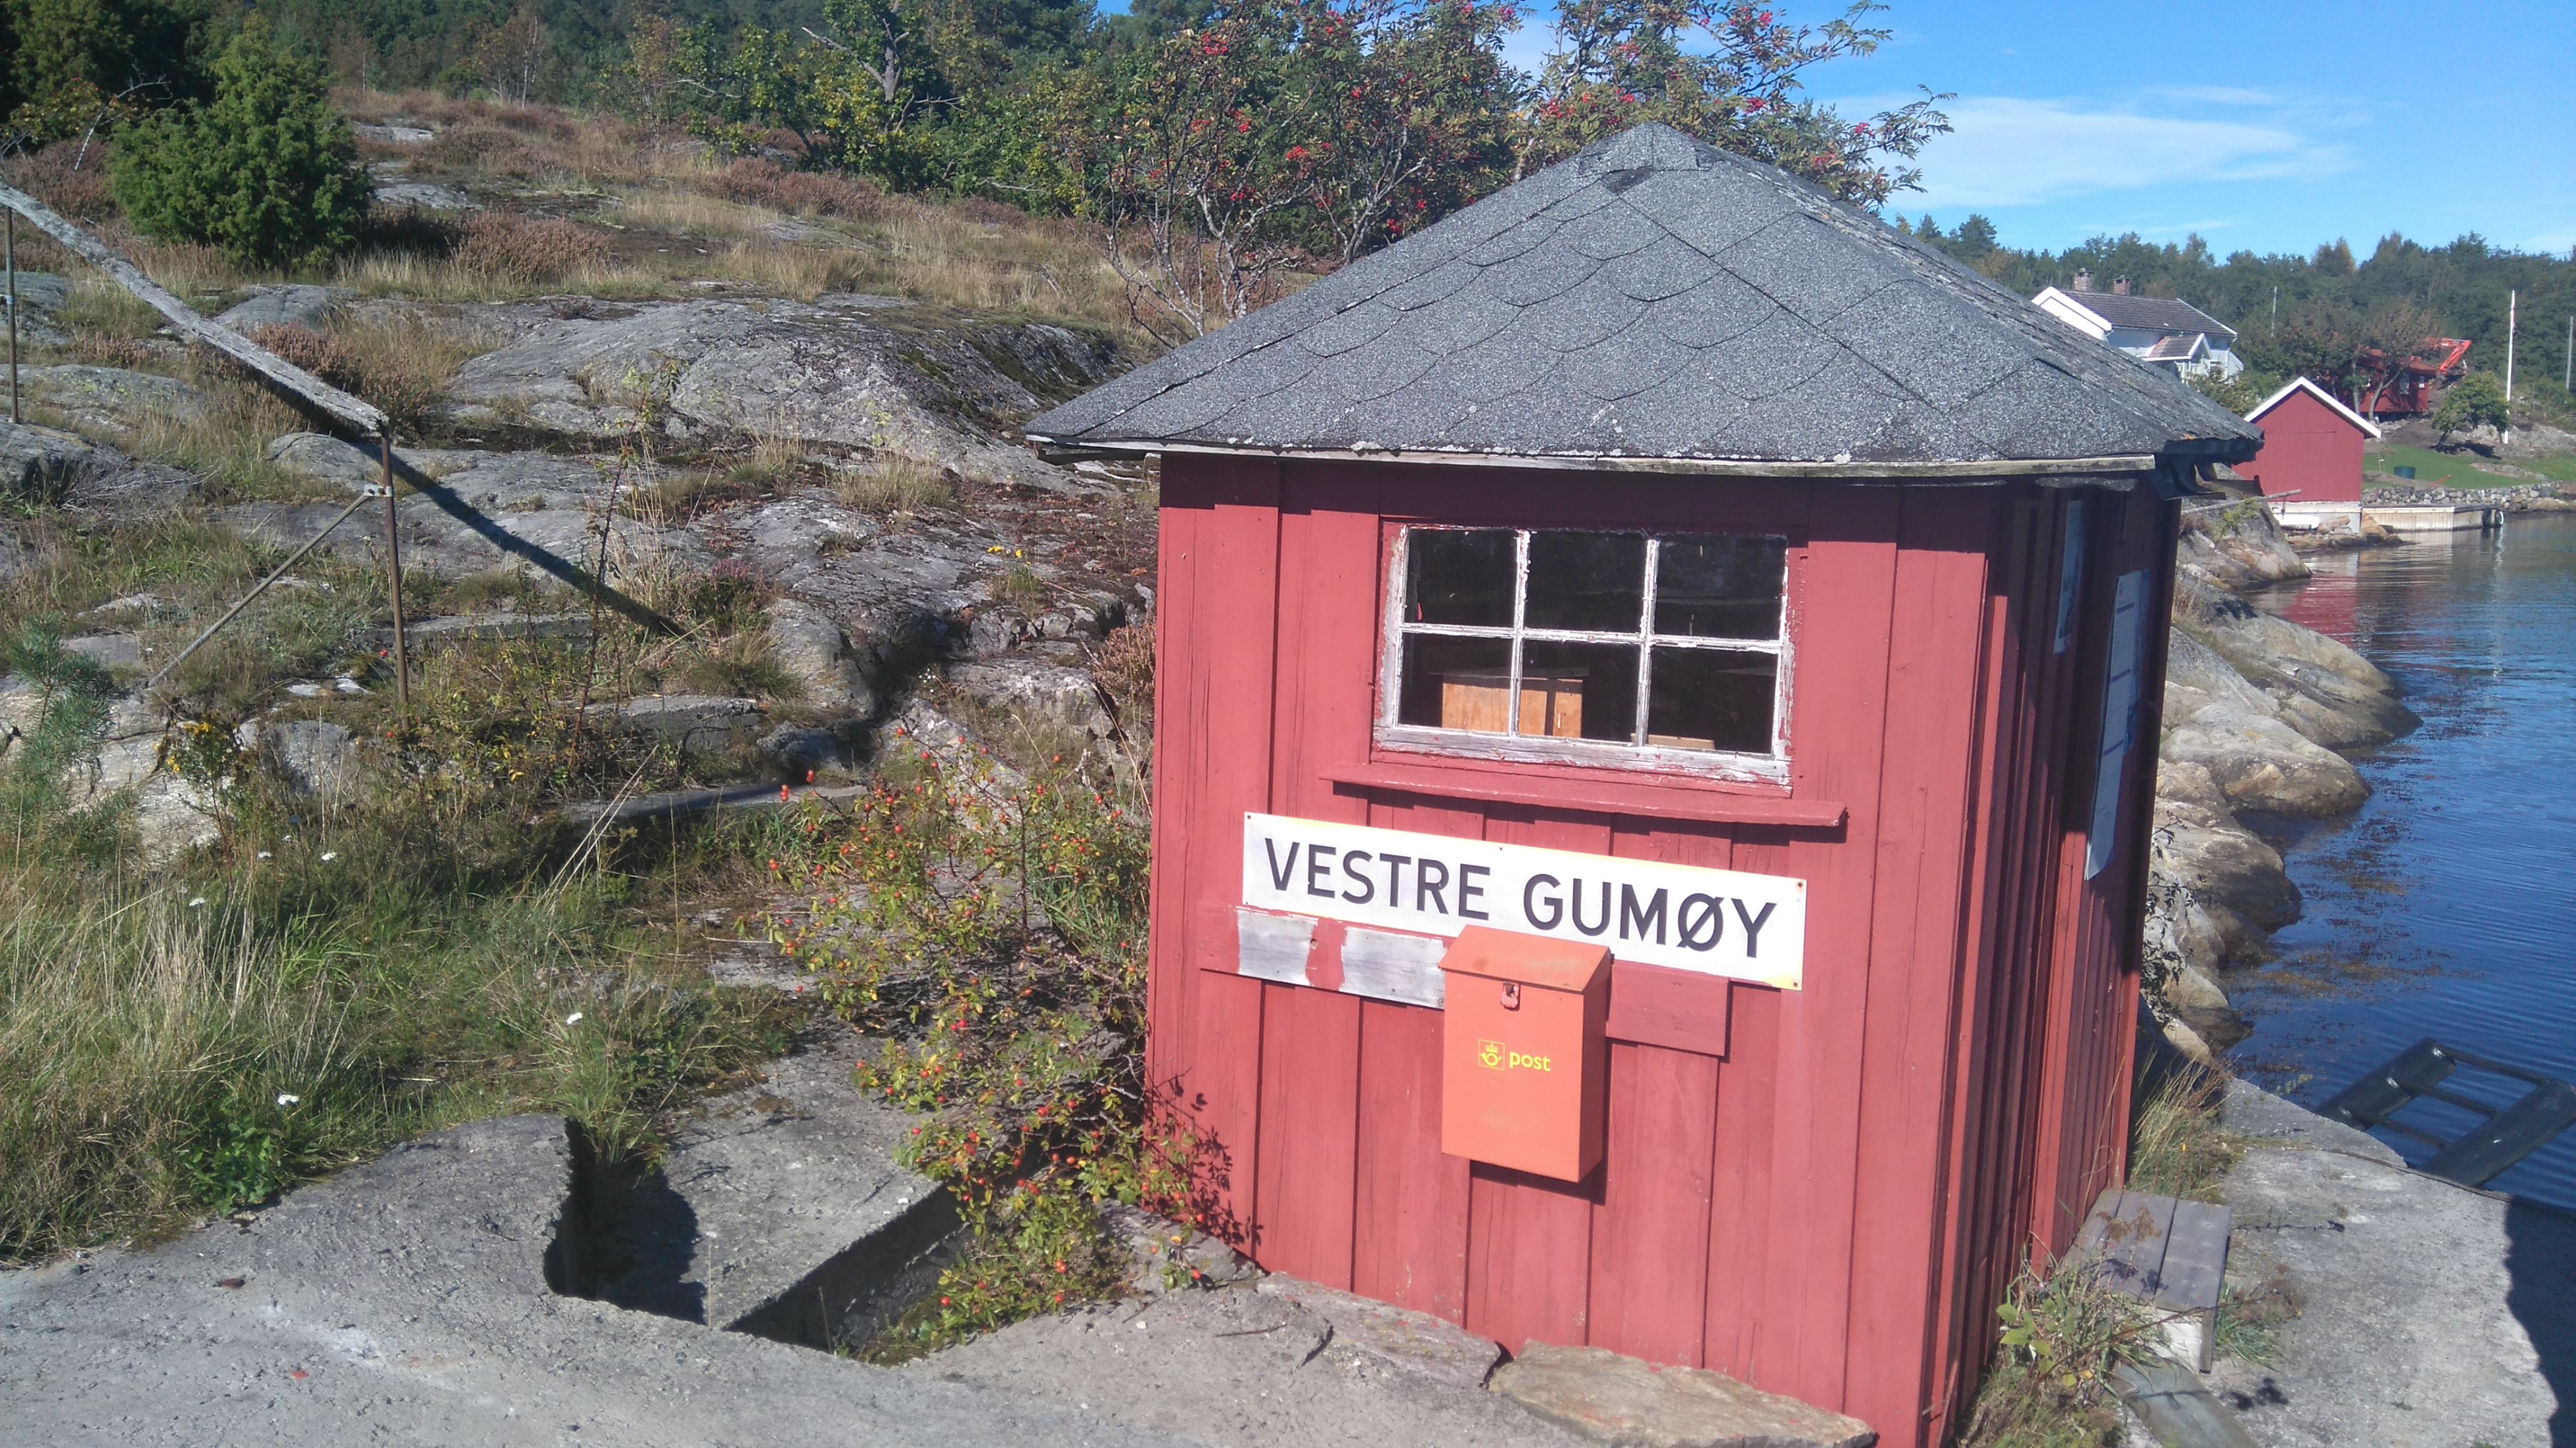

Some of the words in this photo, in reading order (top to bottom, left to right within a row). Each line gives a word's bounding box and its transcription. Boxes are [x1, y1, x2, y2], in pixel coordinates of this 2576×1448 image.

[1265, 838, 1491, 921] VESTRE
[1523, 873, 1778, 959] GUMØY
[1509, 1051, 1551, 1072] post
